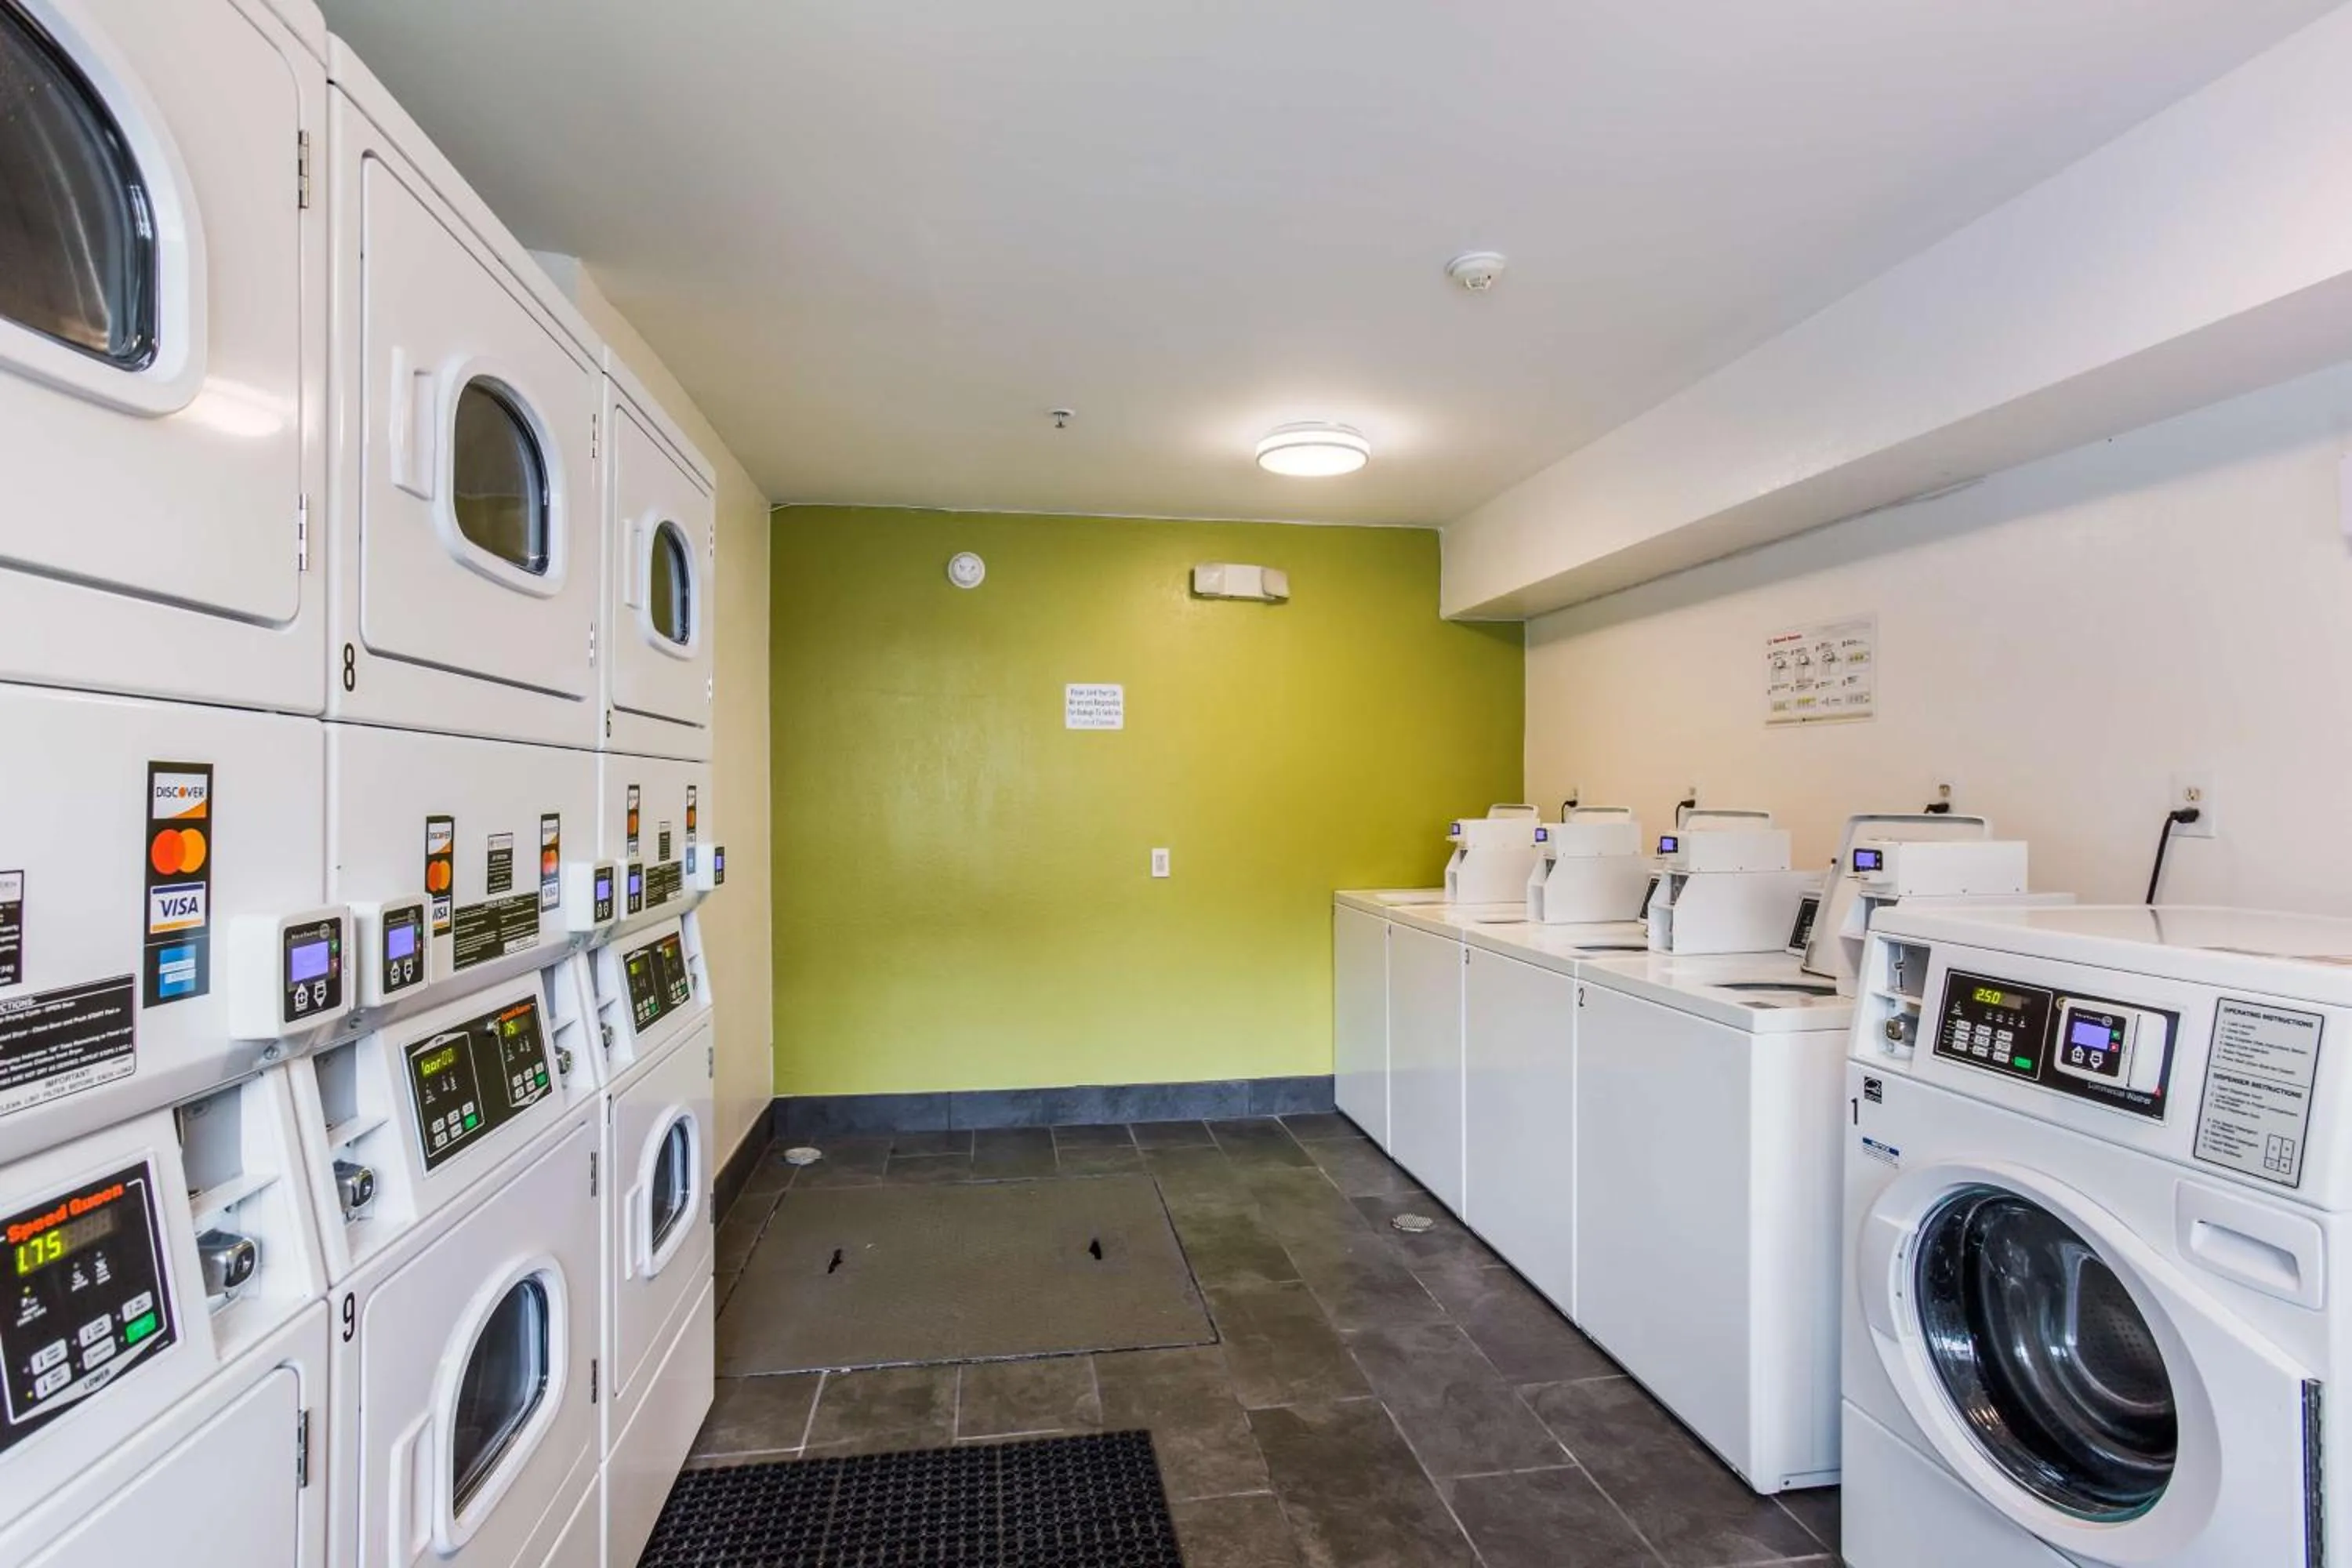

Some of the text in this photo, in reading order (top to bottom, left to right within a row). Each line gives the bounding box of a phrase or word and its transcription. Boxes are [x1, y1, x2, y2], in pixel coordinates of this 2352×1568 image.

[343, 642, 355, 691] 8
[156, 786, 205, 798] DISCOVER
[159, 896, 199, 918] VISA
[1578, 987, 1584, 1007] 2
[1851, 1098, 1858, 1126] 1
[7, 1183, 125, 1243] Speed Queen
[343, 1291, 356, 1343] 9
[82, 1368, 111, 1390] LOWER
